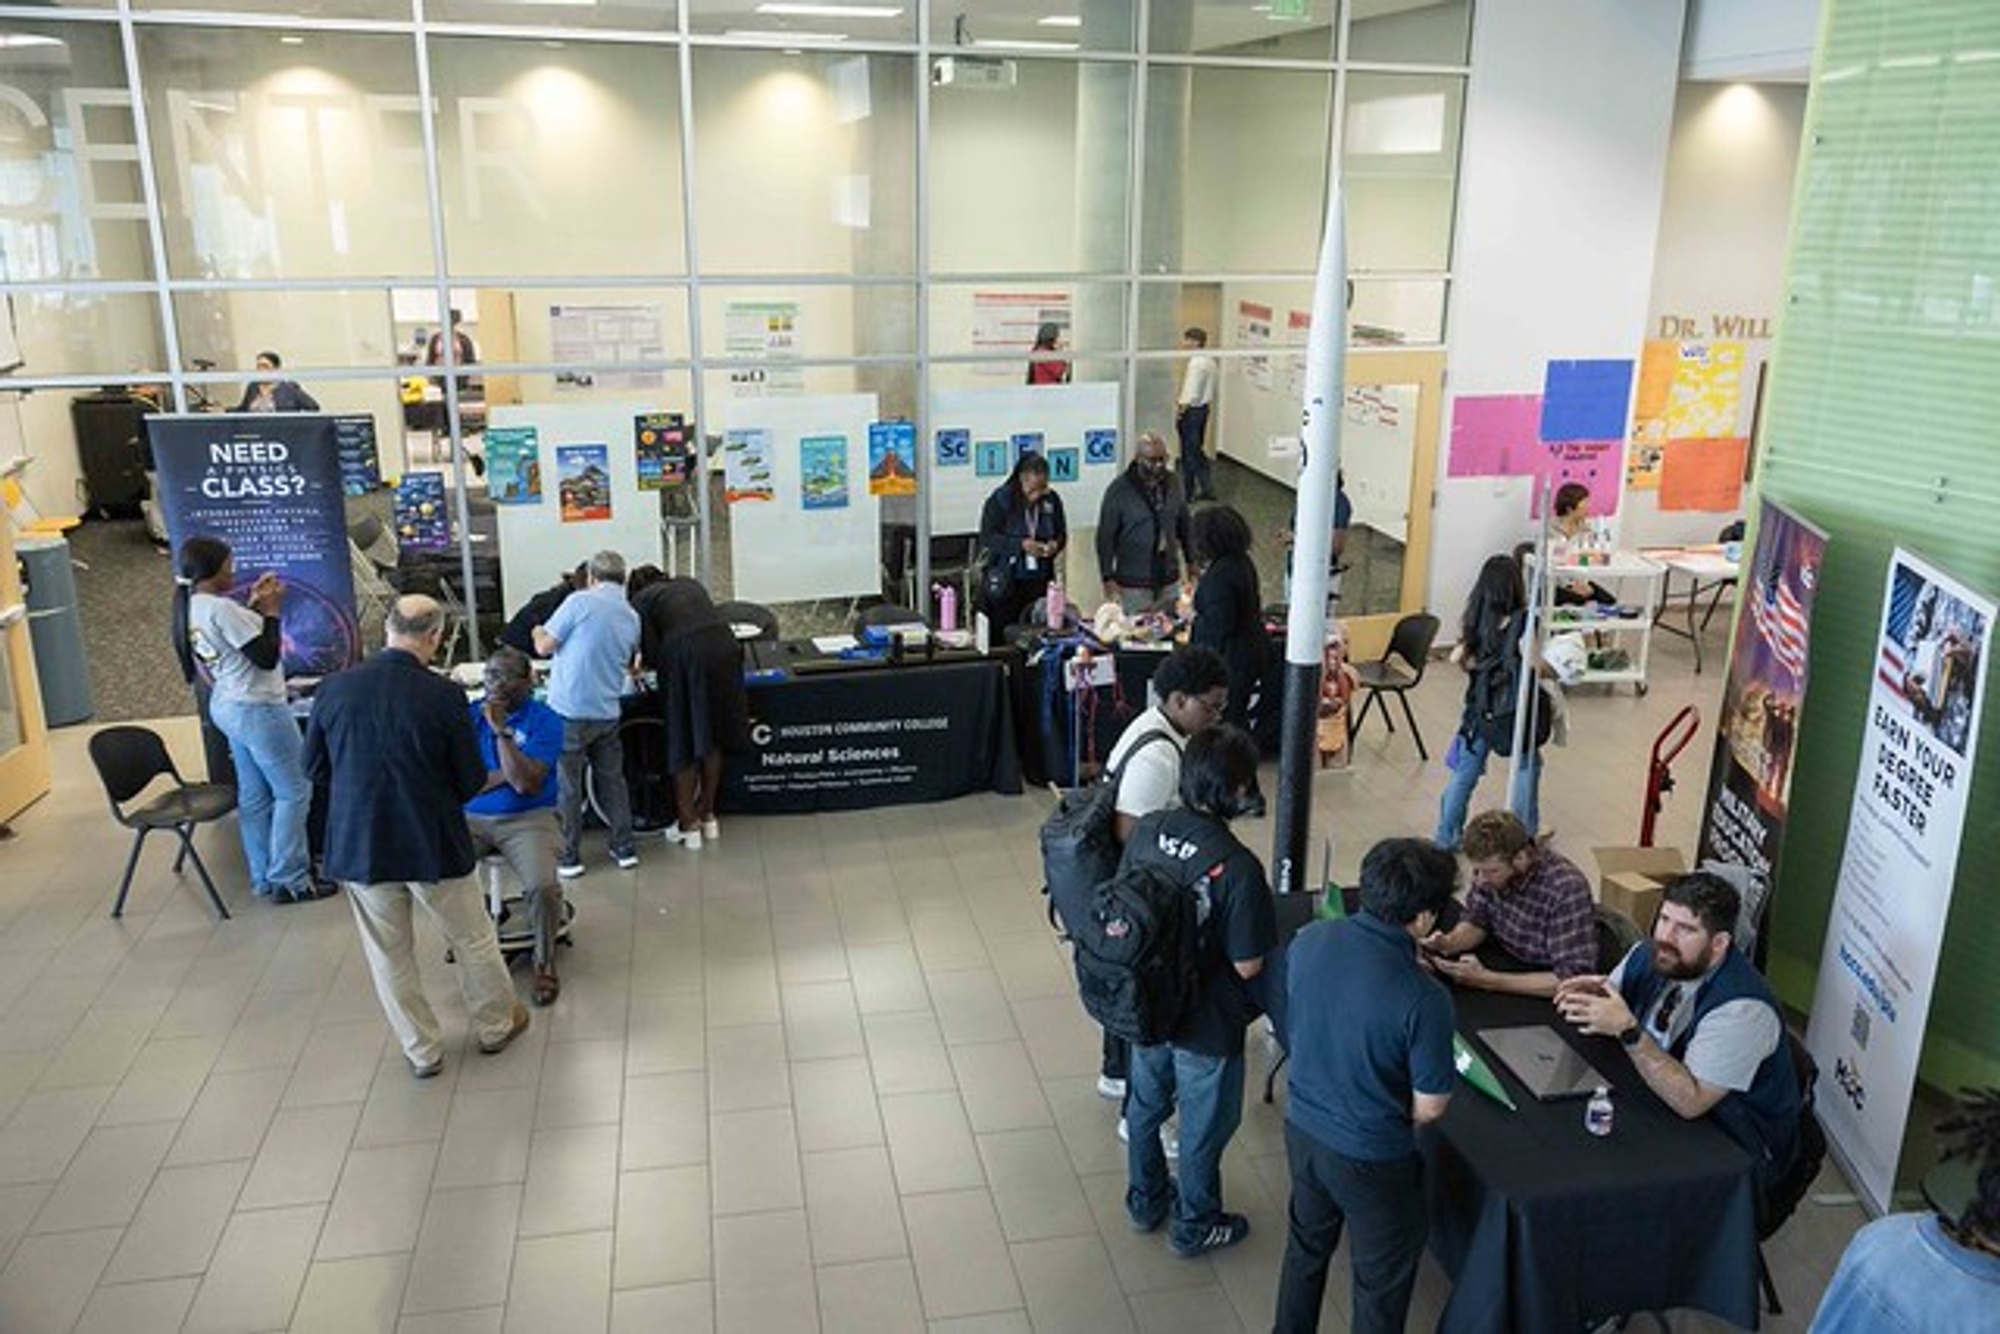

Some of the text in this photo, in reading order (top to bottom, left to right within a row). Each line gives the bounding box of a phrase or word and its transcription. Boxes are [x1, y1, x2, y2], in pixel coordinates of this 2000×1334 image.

[209, 442, 289, 464] NEED
[201, 474, 306, 499] CLASS?
[780, 724, 833, 738] HOUSTON
[834, 720, 902, 736] COMMUNITY
[902, 716, 949, 731] COLLEGE
[761, 746, 900, 767] Natural Sciences
[1874, 704, 1956, 790] EARN YOUR
[1877, 742, 1935, 808] DEGREE
[1871, 771, 1927, 837] FASTER
